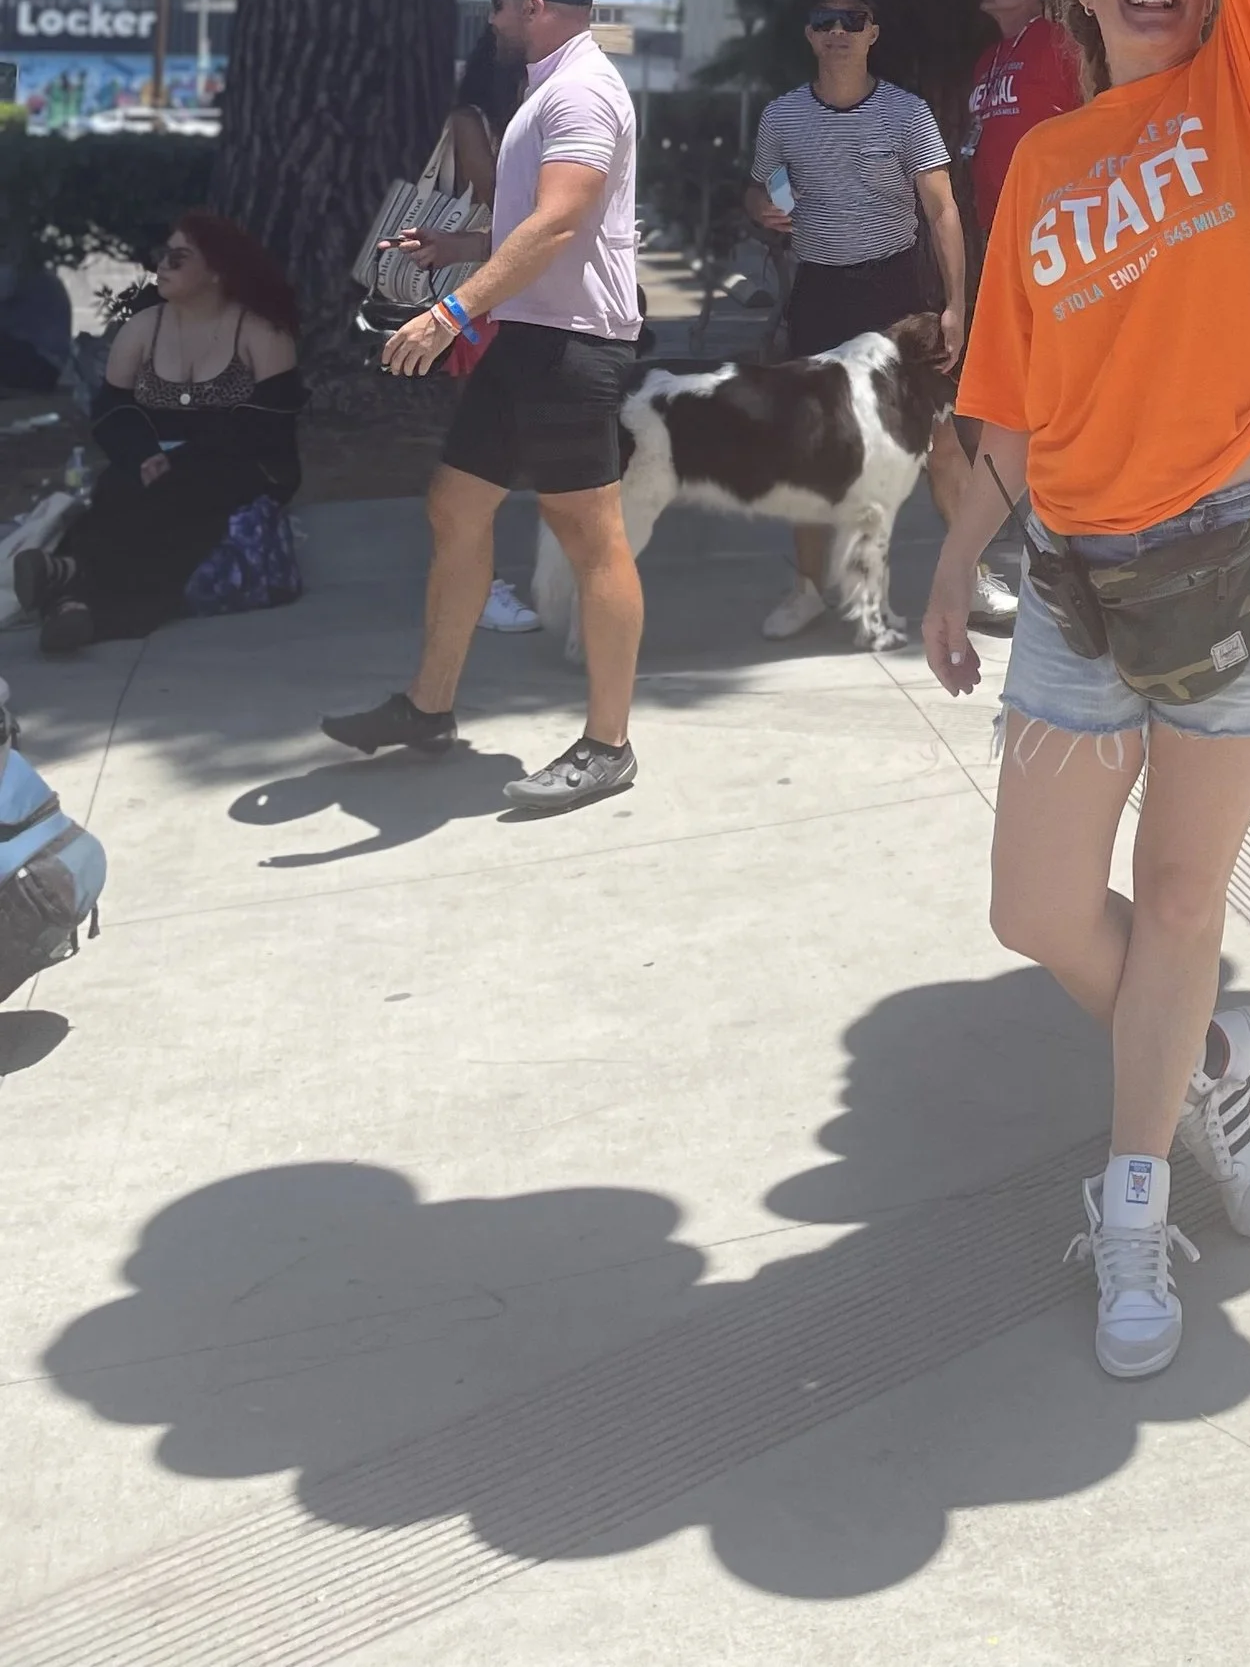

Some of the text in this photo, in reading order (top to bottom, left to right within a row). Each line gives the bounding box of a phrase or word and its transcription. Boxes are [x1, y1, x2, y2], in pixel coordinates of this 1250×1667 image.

[17, 1, 157, 35] Locker
[1030, 117, 1208, 286] STAFF
[1066, 291, 1085, 313] TO
[1086, 283, 1104, 304] LA
[1108, 263, 1140, 291] END
[1163, 220, 1193, 247] 545
[1191, 202, 1236, 234] MILES
